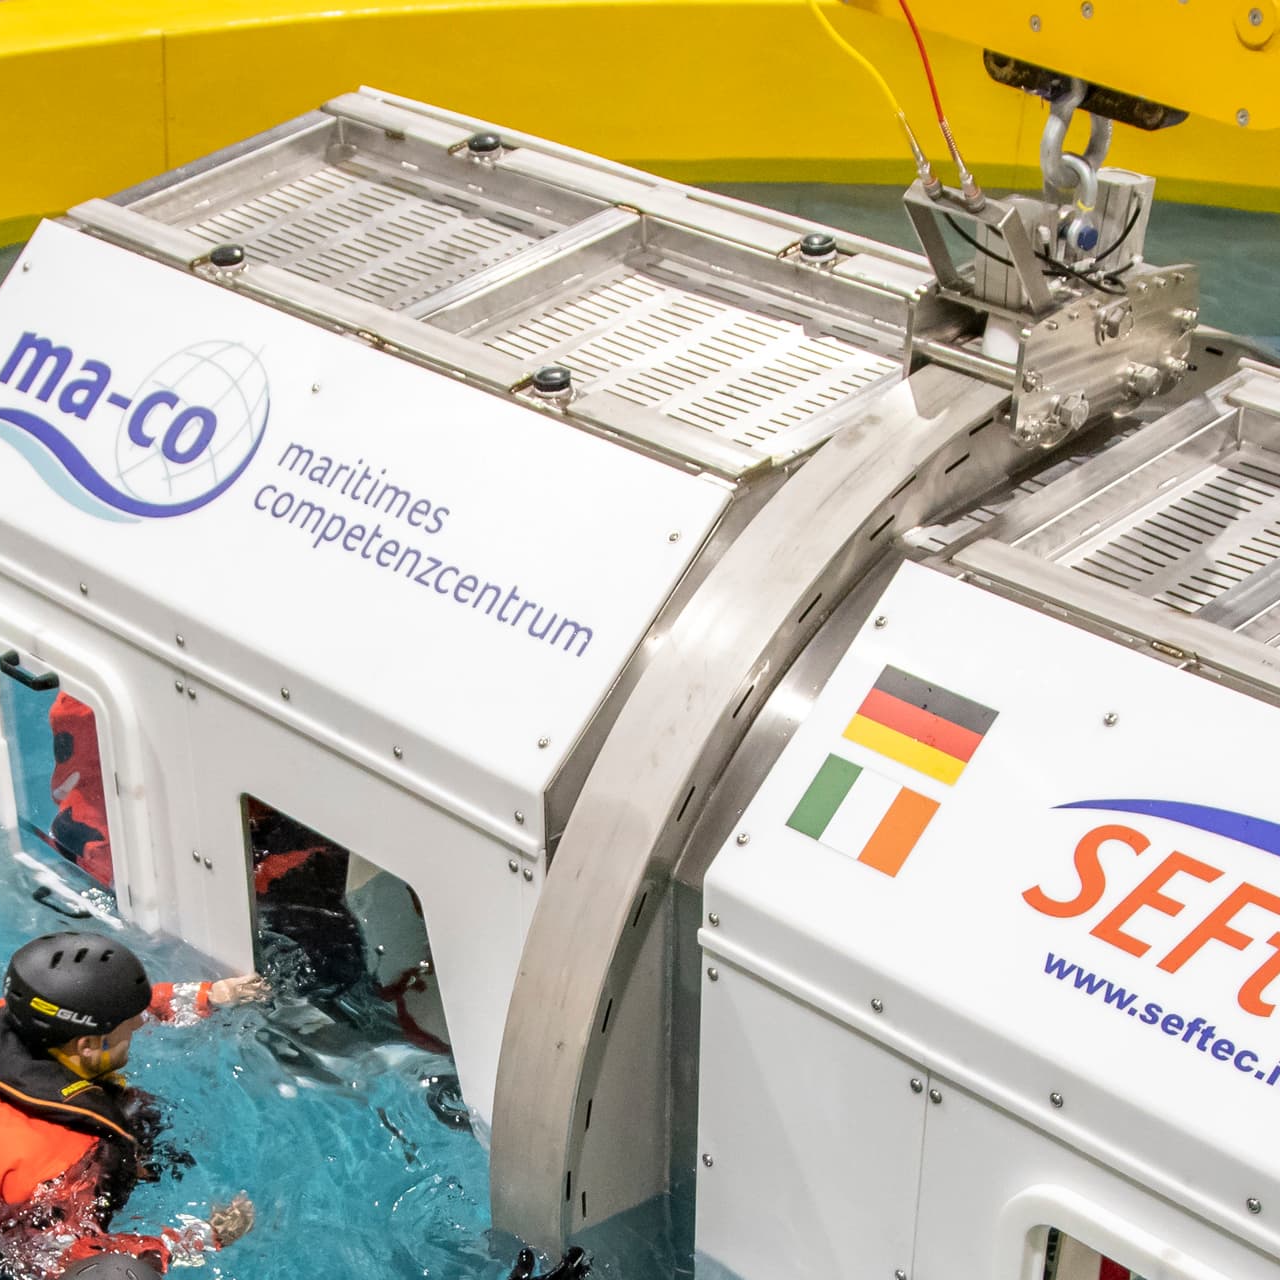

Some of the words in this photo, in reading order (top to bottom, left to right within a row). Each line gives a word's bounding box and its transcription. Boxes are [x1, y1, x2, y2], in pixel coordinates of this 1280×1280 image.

[278, 440, 451, 535] maritimes
[253, 483, 594, 658] competenzcentrum
[56, 1008, 98, 1026] GUL
